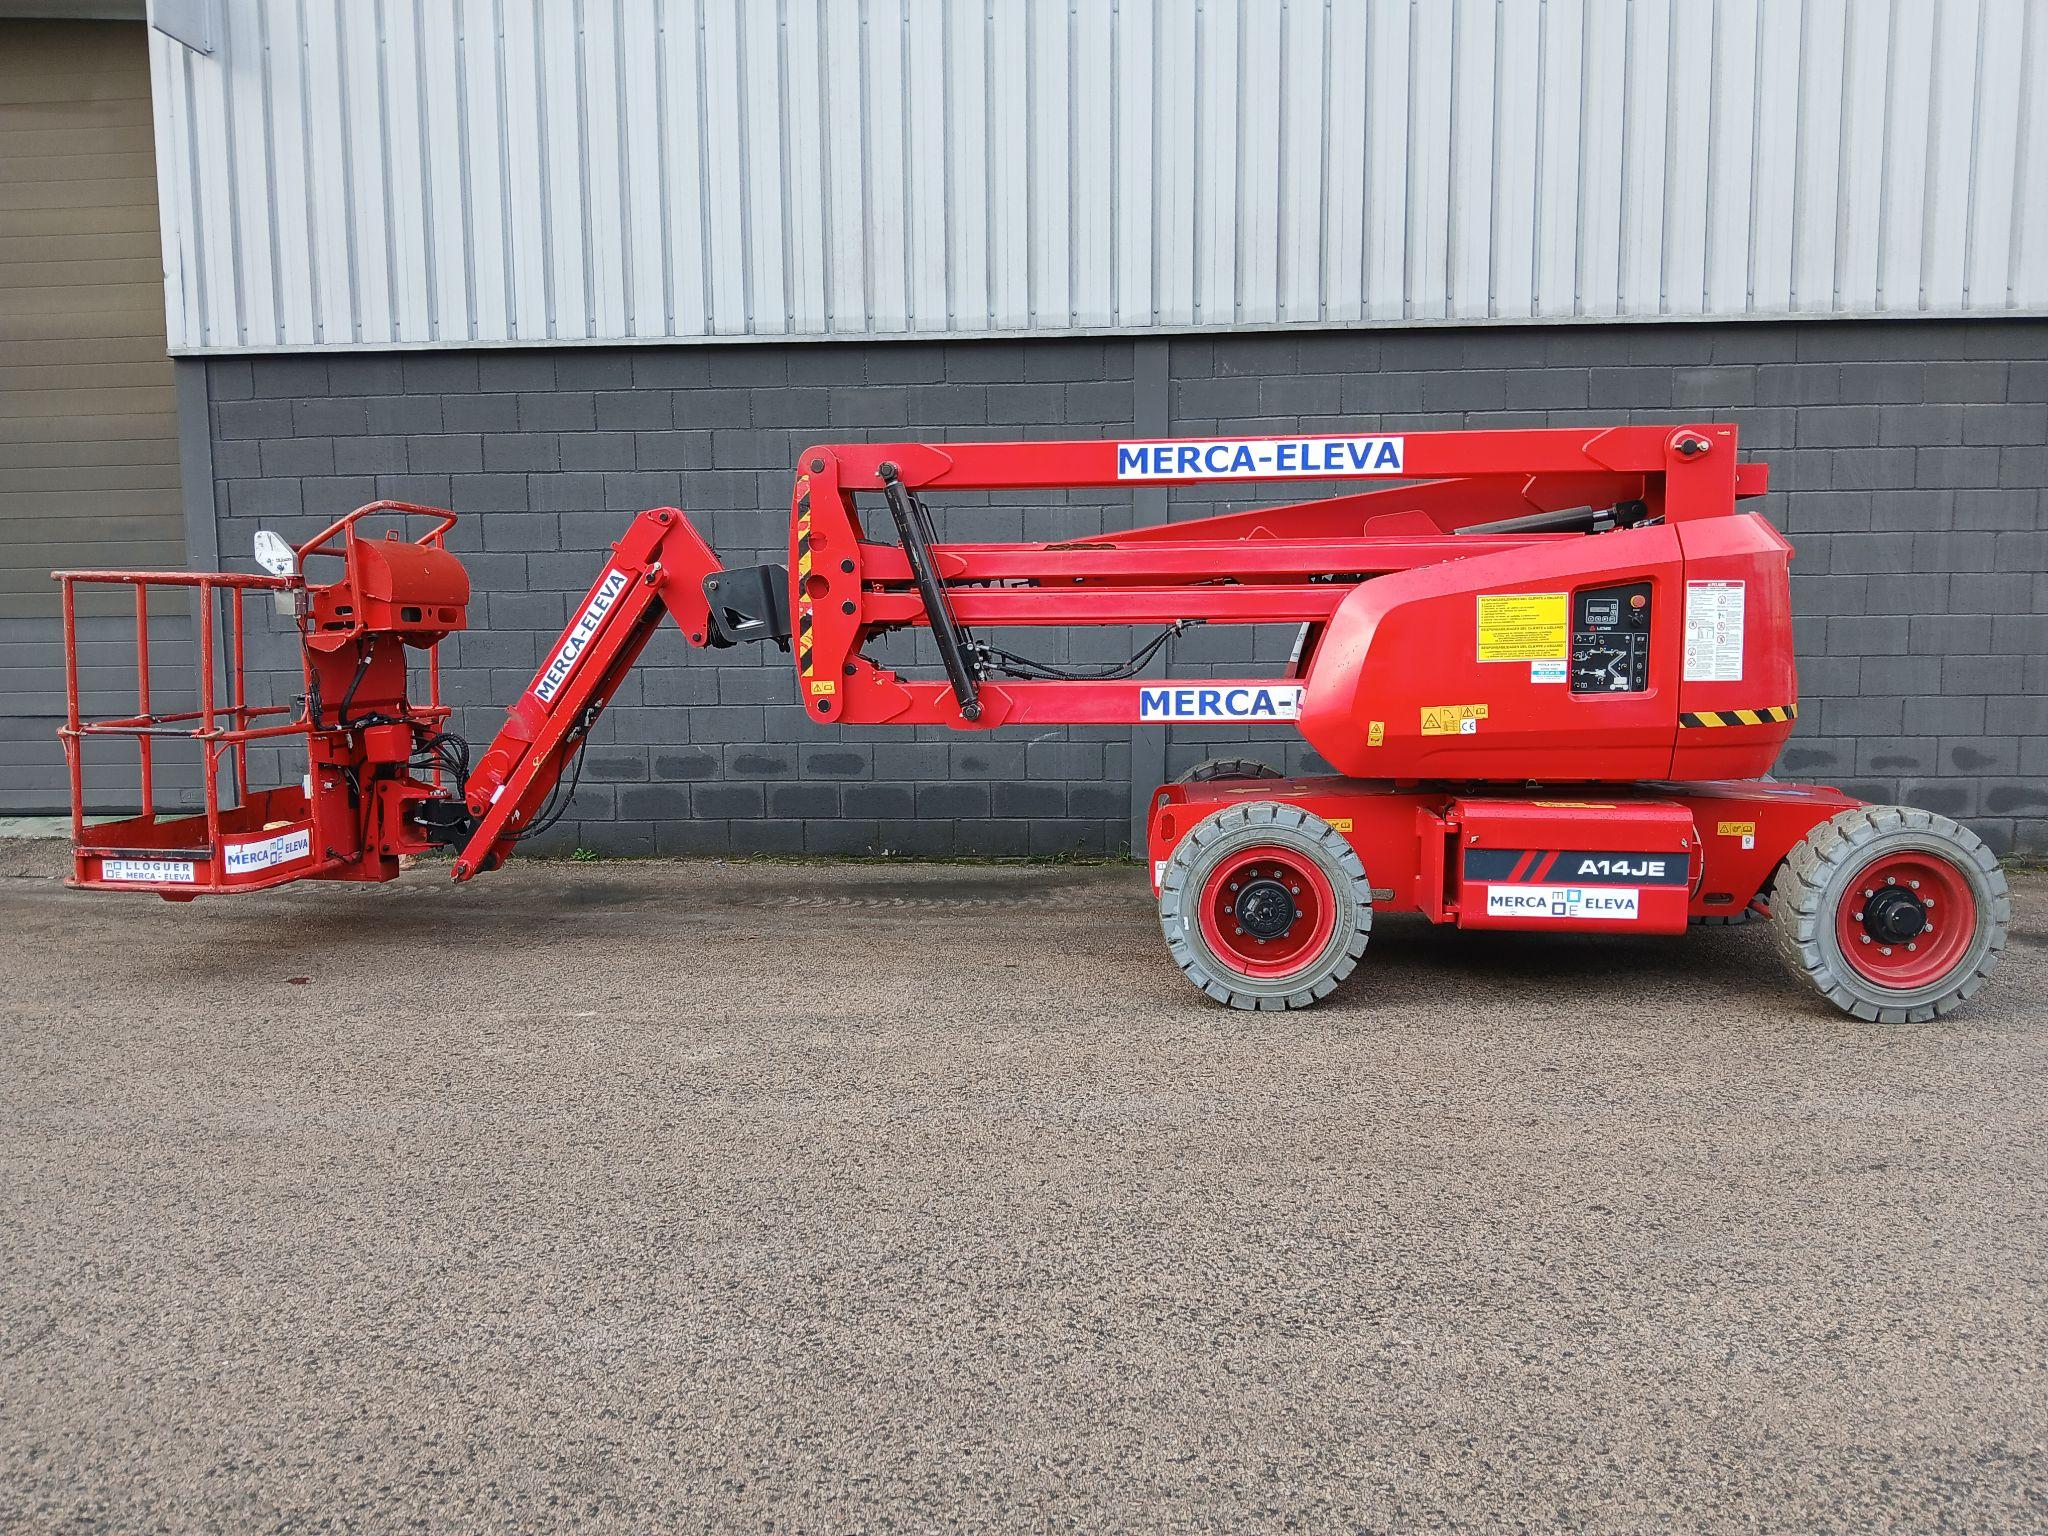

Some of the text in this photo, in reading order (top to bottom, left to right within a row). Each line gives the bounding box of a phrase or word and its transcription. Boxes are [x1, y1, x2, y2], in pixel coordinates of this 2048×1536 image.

[1118, 441, 1401, 475] MERCA-ELEVA
[536, 574, 625, 700] MERCA-ELEVA
[1141, 689, 1303, 717] MERCA-
[227, 838, 308, 866] MERCA ELEVA
[125, 861, 191, 872] LLOGUER
[126, 871, 156, 880] MERCA
[164, 873, 191, 881] ELEVA
[1577, 859, 1666, 877] A14JE
[1490, 895, 1635, 910] MERCA ELEVA
